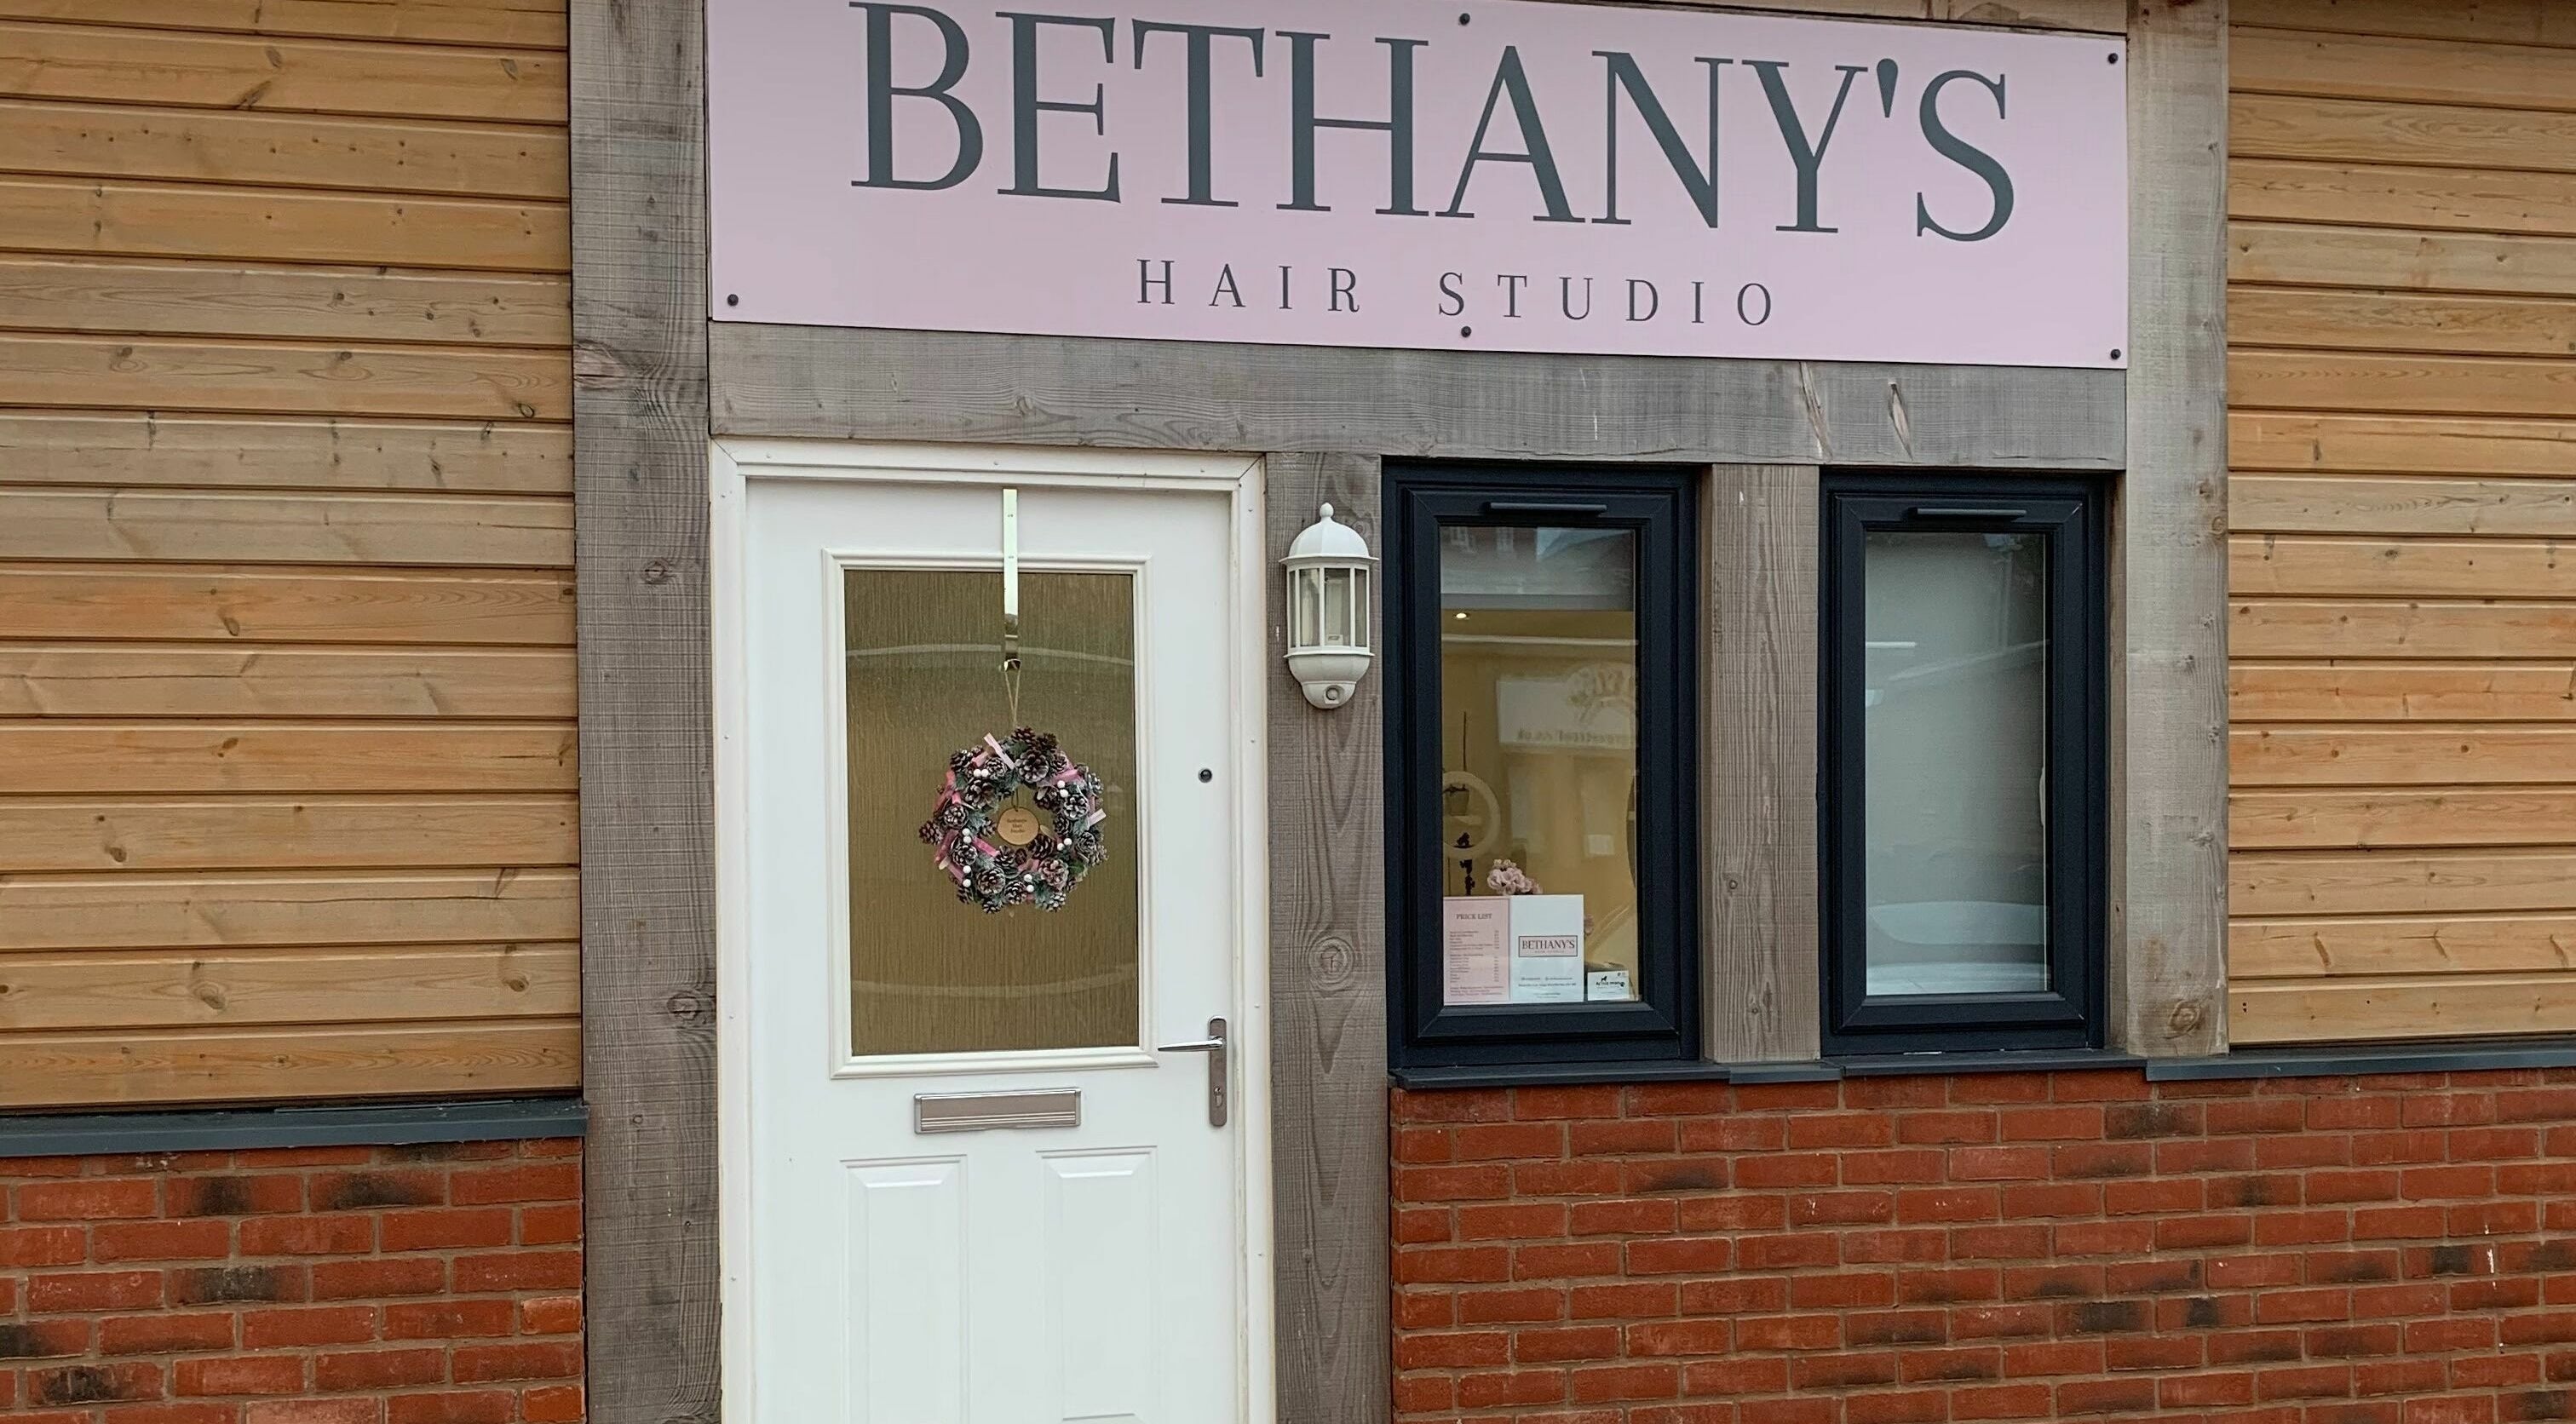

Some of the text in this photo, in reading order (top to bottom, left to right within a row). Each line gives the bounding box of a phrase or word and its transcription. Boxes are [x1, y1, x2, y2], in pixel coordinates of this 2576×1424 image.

[848, 1, 2015, 242] BETHANY'S
[1136, 258, 1772, 326] HAIR STUDIO
[1521, 939, 1575, 950] BETHANY'S
